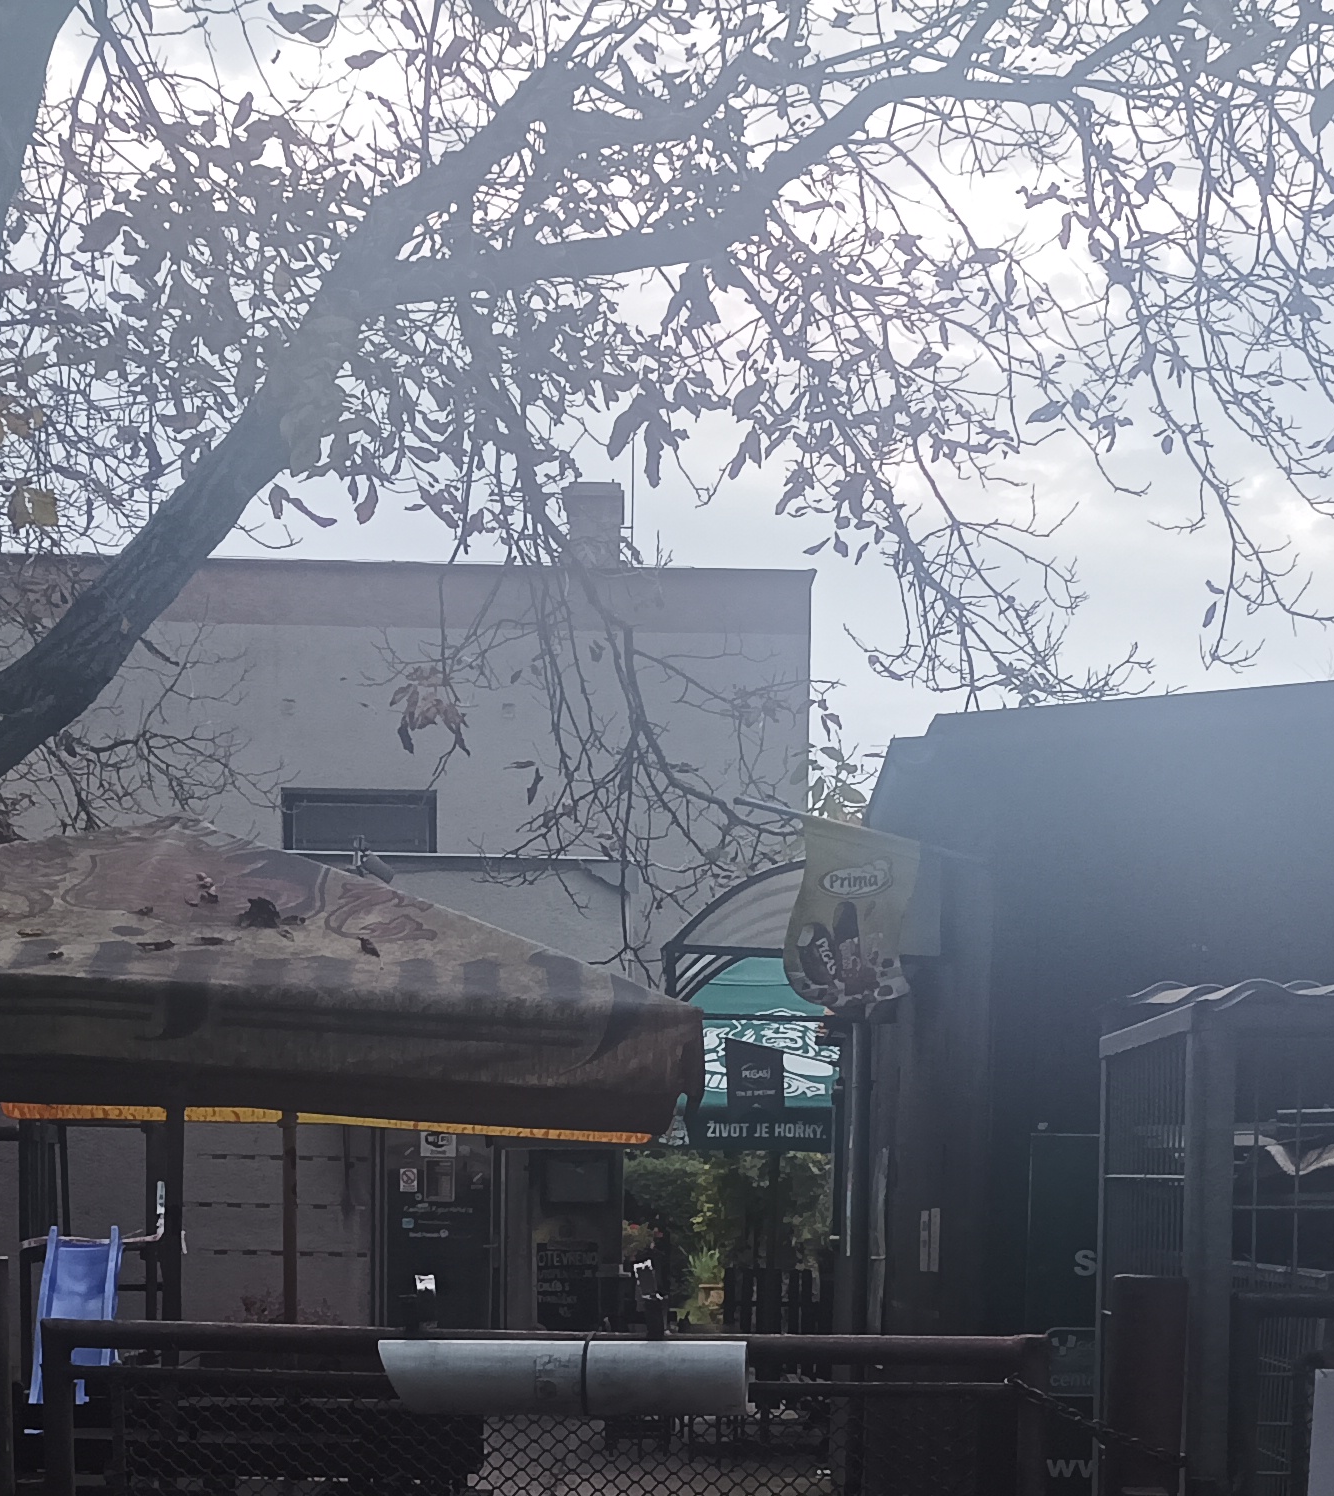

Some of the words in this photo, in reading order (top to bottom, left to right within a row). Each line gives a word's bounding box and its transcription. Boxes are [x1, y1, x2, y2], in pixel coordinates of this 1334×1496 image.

[829, 873, 879, 890] Prima
[707, 1120, 749, 1138] ŽIVOT
[754, 1123, 769, 1138] JE
